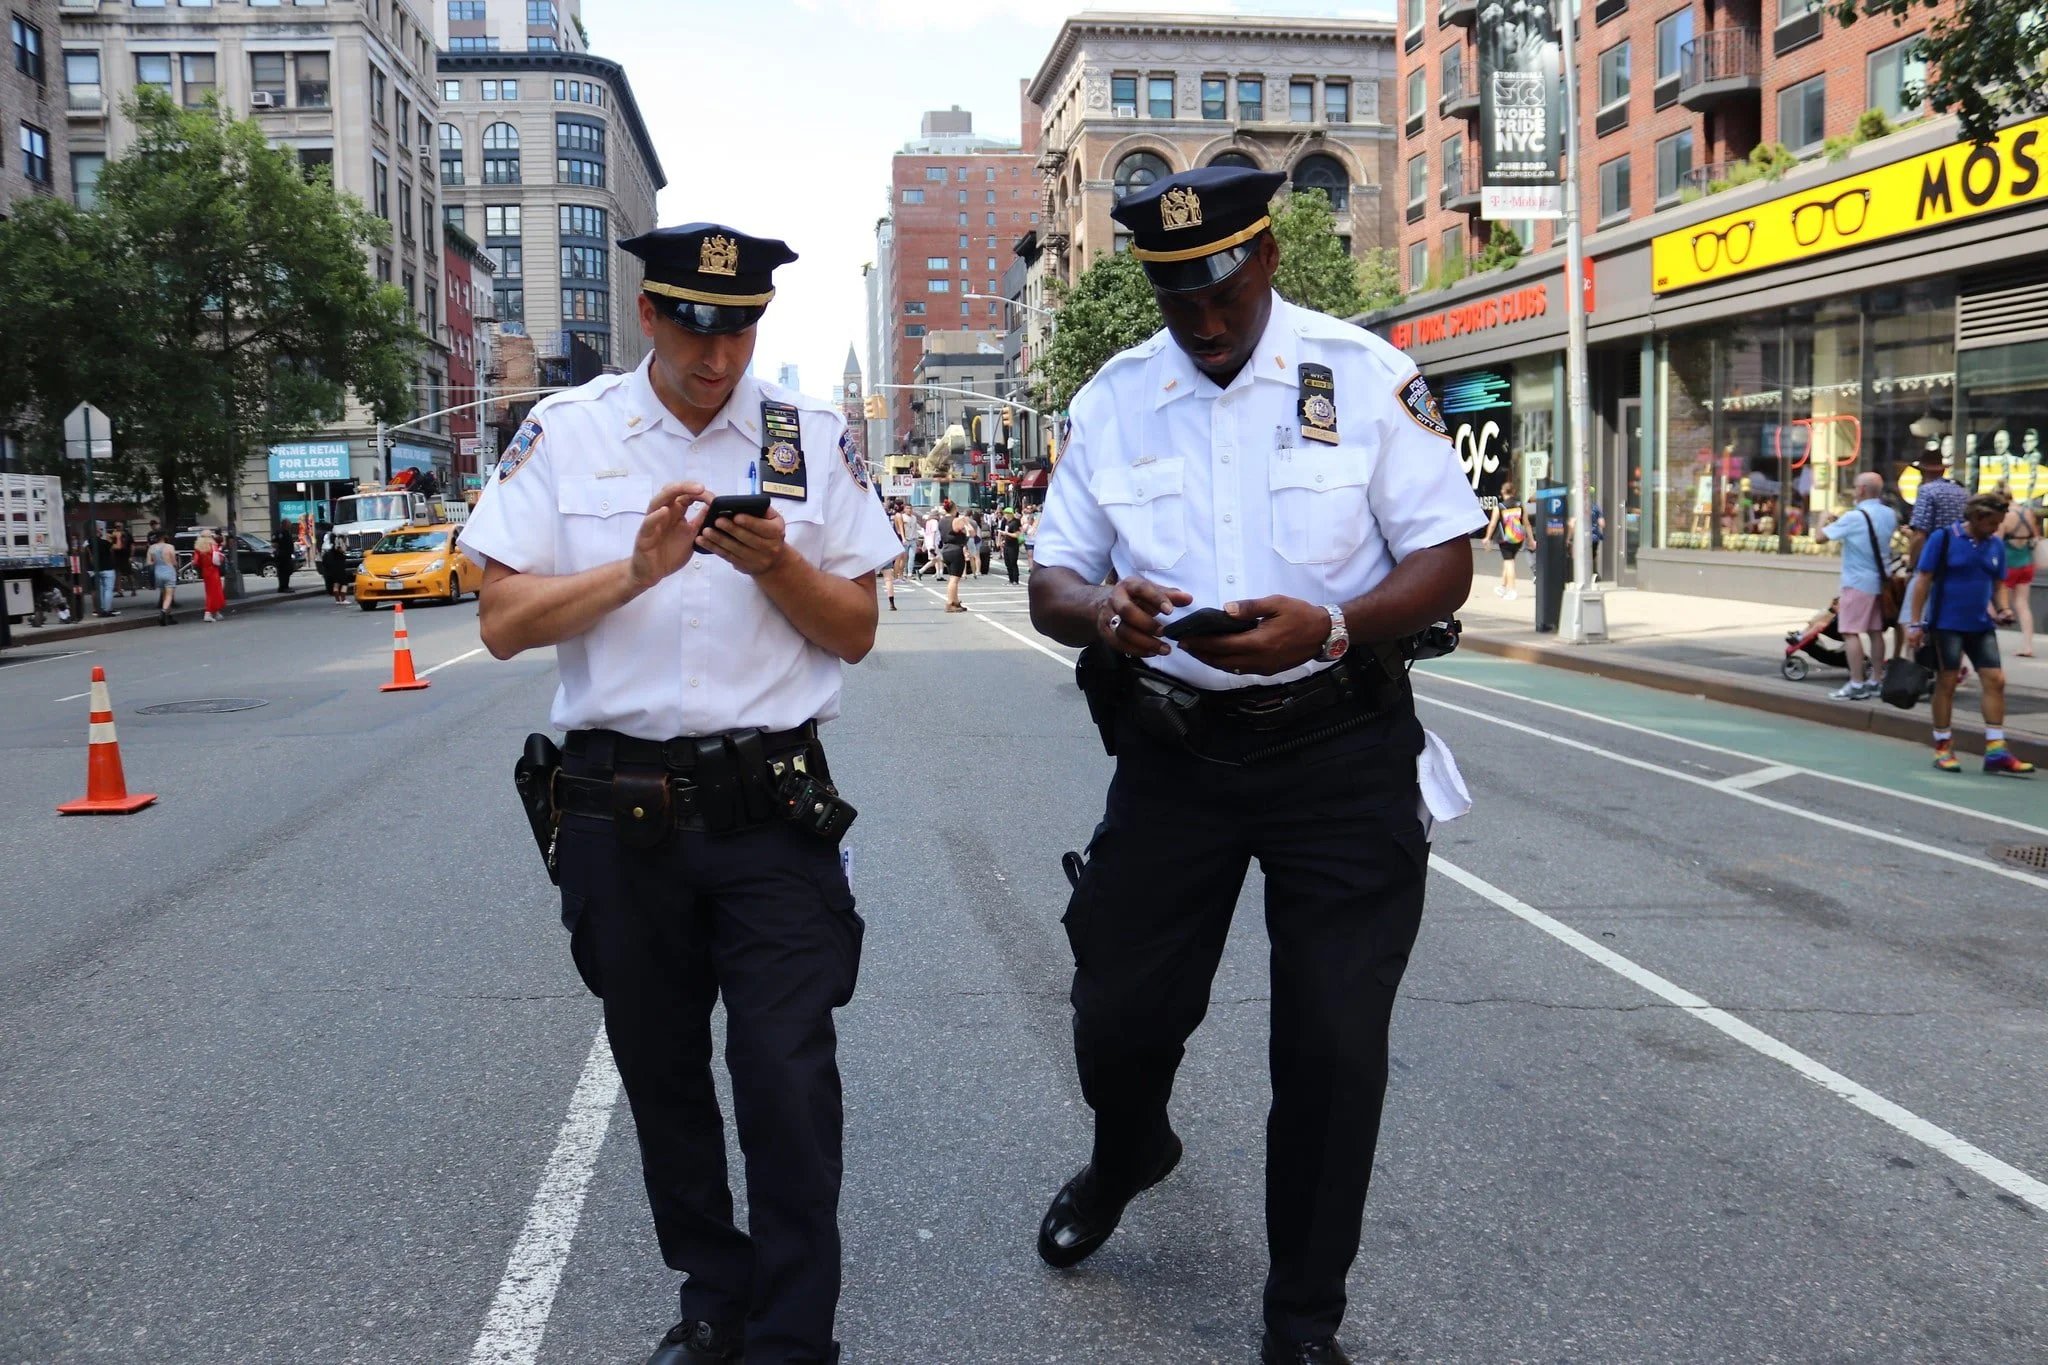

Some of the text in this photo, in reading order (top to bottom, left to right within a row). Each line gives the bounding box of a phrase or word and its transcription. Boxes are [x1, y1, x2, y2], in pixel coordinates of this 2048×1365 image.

[1493, 71, 1545, 79] STONEWALL
[1494, 107, 1546, 119] WORLD
[1495, 119, 1546, 132] PRIDE
[1495, 132, 1546, 153] NYC
[1391, 283, 1547, 350] NEW YORK SPORTS CLUBS
[1416, 413, 1435, 427] CITY
[309, 445, 346, 455] RETAIL
[279, 457, 338, 468] FOR LEASE
[1479, 496, 1499, 511] ASED
[1553, 501, 1562, 513] P
